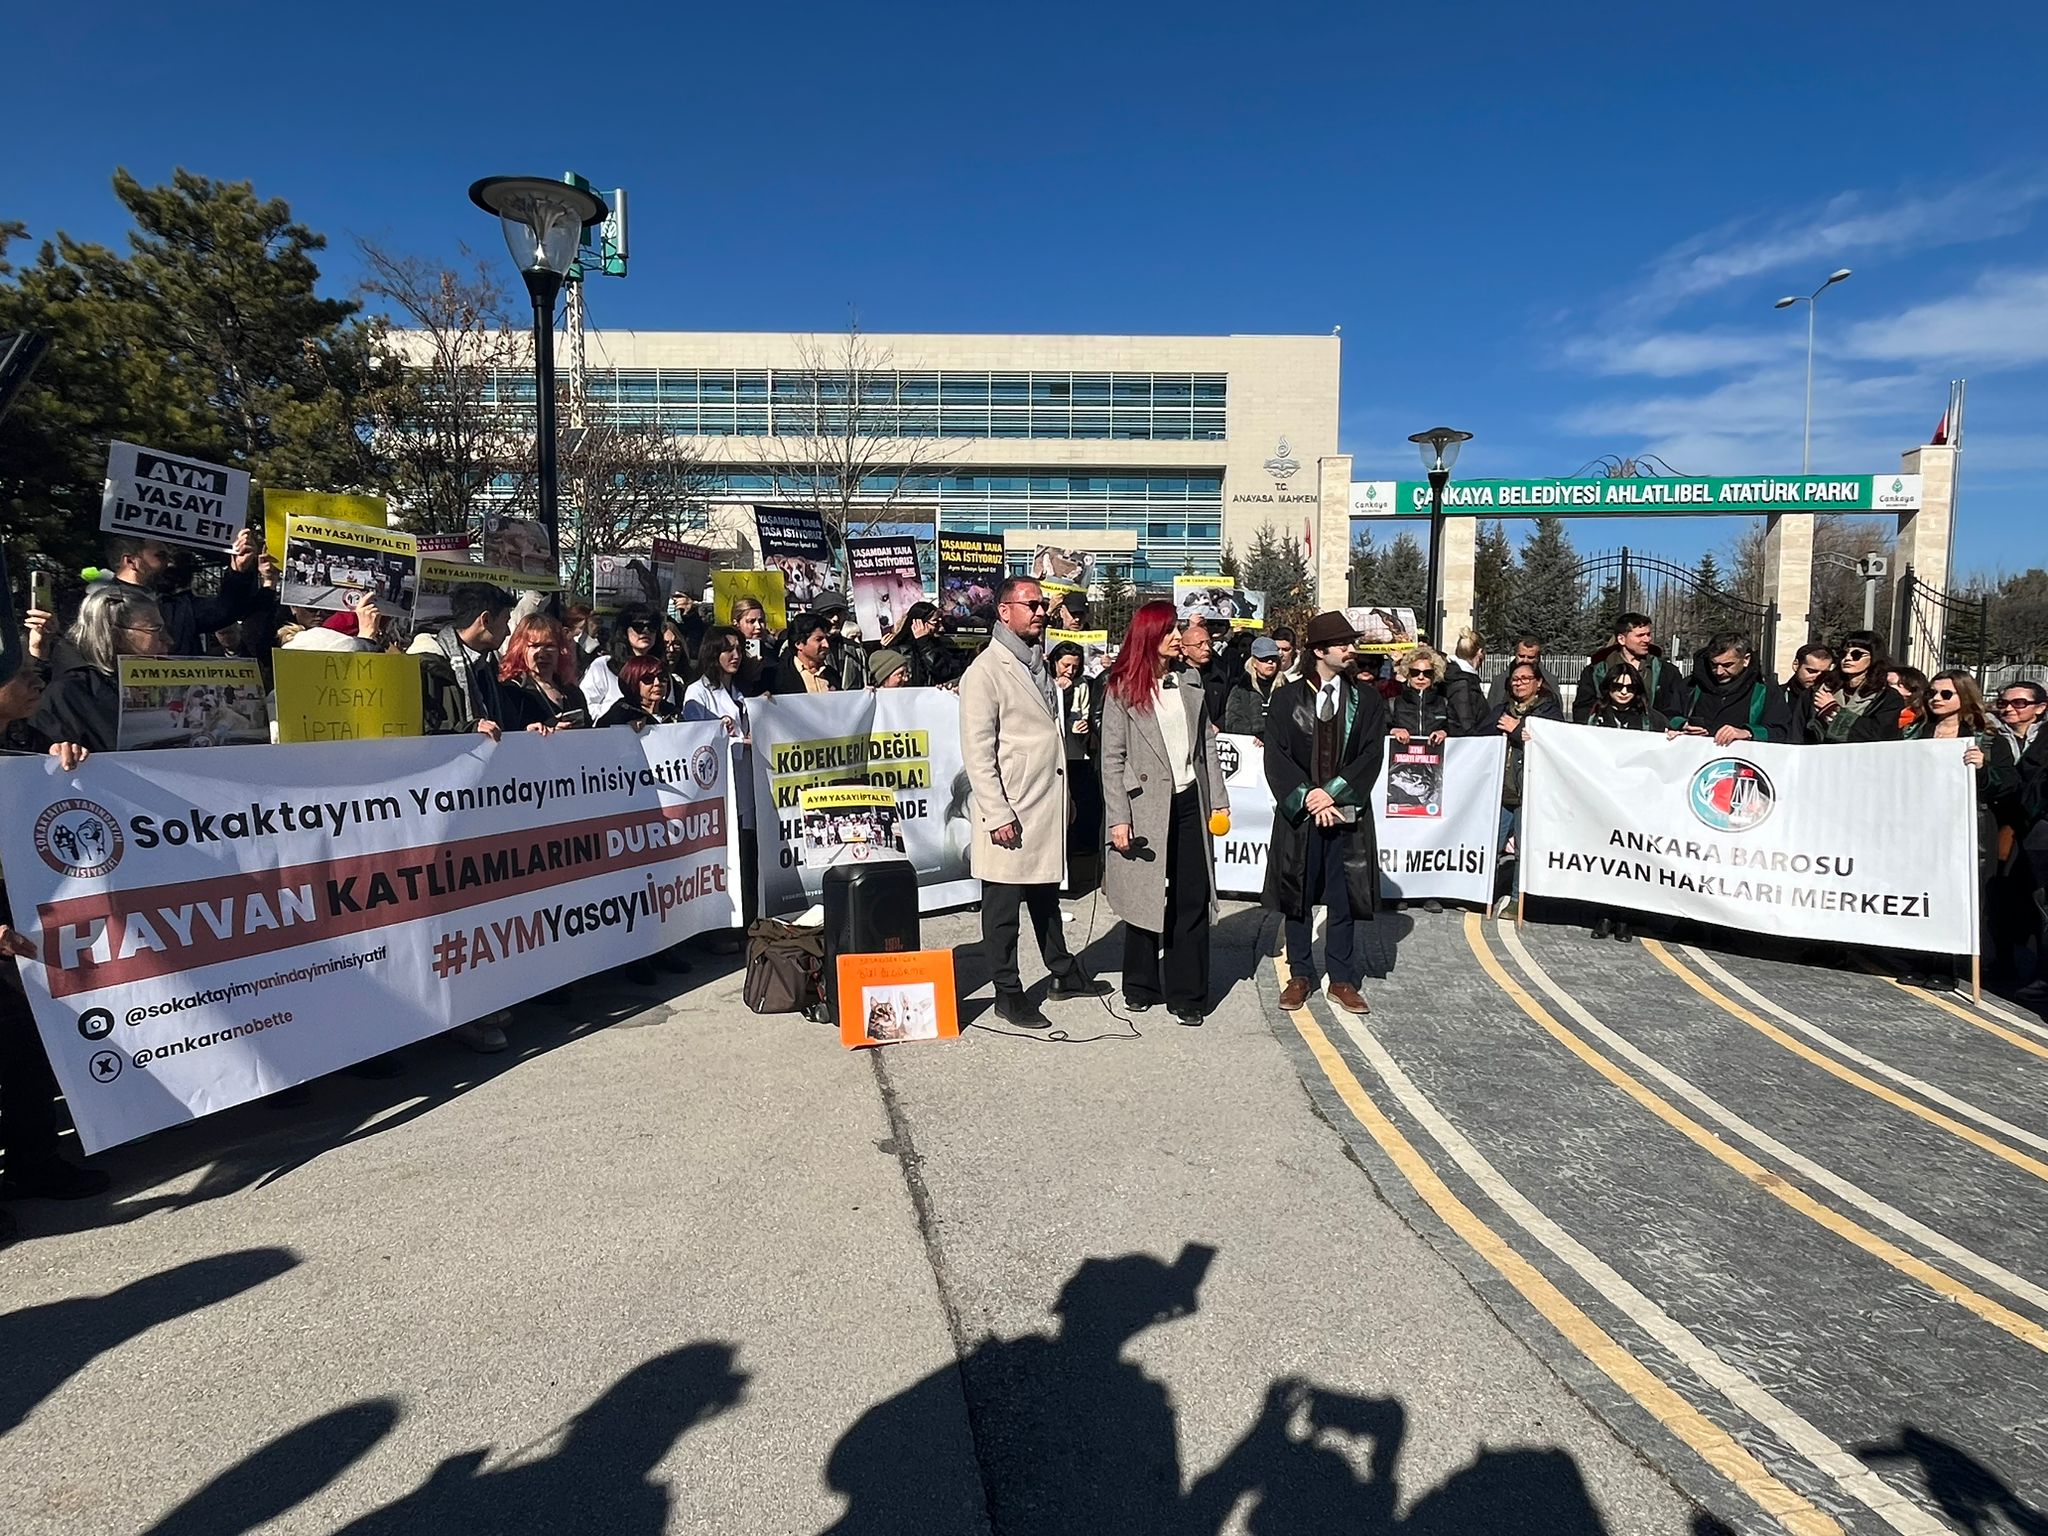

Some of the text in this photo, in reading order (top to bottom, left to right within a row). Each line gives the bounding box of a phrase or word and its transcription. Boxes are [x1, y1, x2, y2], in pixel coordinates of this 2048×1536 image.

[148, 461, 215, 492] AYM
[135, 482, 222, 518] YASAYI
[1232, 494, 1275, 503] ANAYASA
[1413, 480, 1860, 511] ÇANKAYA BELEDİYESİ AHLATLIBEL ATATÜRK PARKI
[114, 498, 234, 541] İPTAL ET!
[758, 514, 821, 529] YAŞAMDAN YANA
[760, 526, 823, 540] YASA İSTİYORUZ
[296, 524, 411, 551] AYM YASAYI İPTAL ET!
[940, 539, 1002, 553] YAŞAMDAN YANA
[852, 546, 912, 558] YAŞAMDAN YANA
[853, 556, 914, 568] YASA İSTİYORUZ
[940, 551, 1003, 565] YASA İSTİYORUZ
[427, 566, 447, 576] AYM
[729, 575, 768, 589] AYM
[130, 666, 255, 679] AYM YASAYI İPTAL ET!
[324, 655, 373, 681] AYM
[315, 685, 384, 708] YASAYI
[777, 733, 922, 774] KÖPEKLERİ DEĞİL
[129, 796, 401, 849] Sokaktayım
[409, 775, 576, 817] Yanındayım
[581, 758, 690, 793] İnisiyatifi
[807, 795, 827, 804] AYM
[829, 793, 859, 802] YASAYI
[860, 792, 881, 802] İPTAL
[1406, 843, 1485, 875] MECLİSİ
[1609, 829, 1855, 877] ANKARA BAROSU
[58, 808, 720, 971] HAYVAN KATLİAMLARINI DURDUR!
[1548, 851, 1930, 918] HAYVAN HAKLARI MERKEZİ
[432, 863, 727, 979] #AYMYasayıİptalEt
[125, 945, 388, 1027] @sokaktayimyanindayiminisiyatif
[132, 1009, 294, 1069] @ankaranobette
